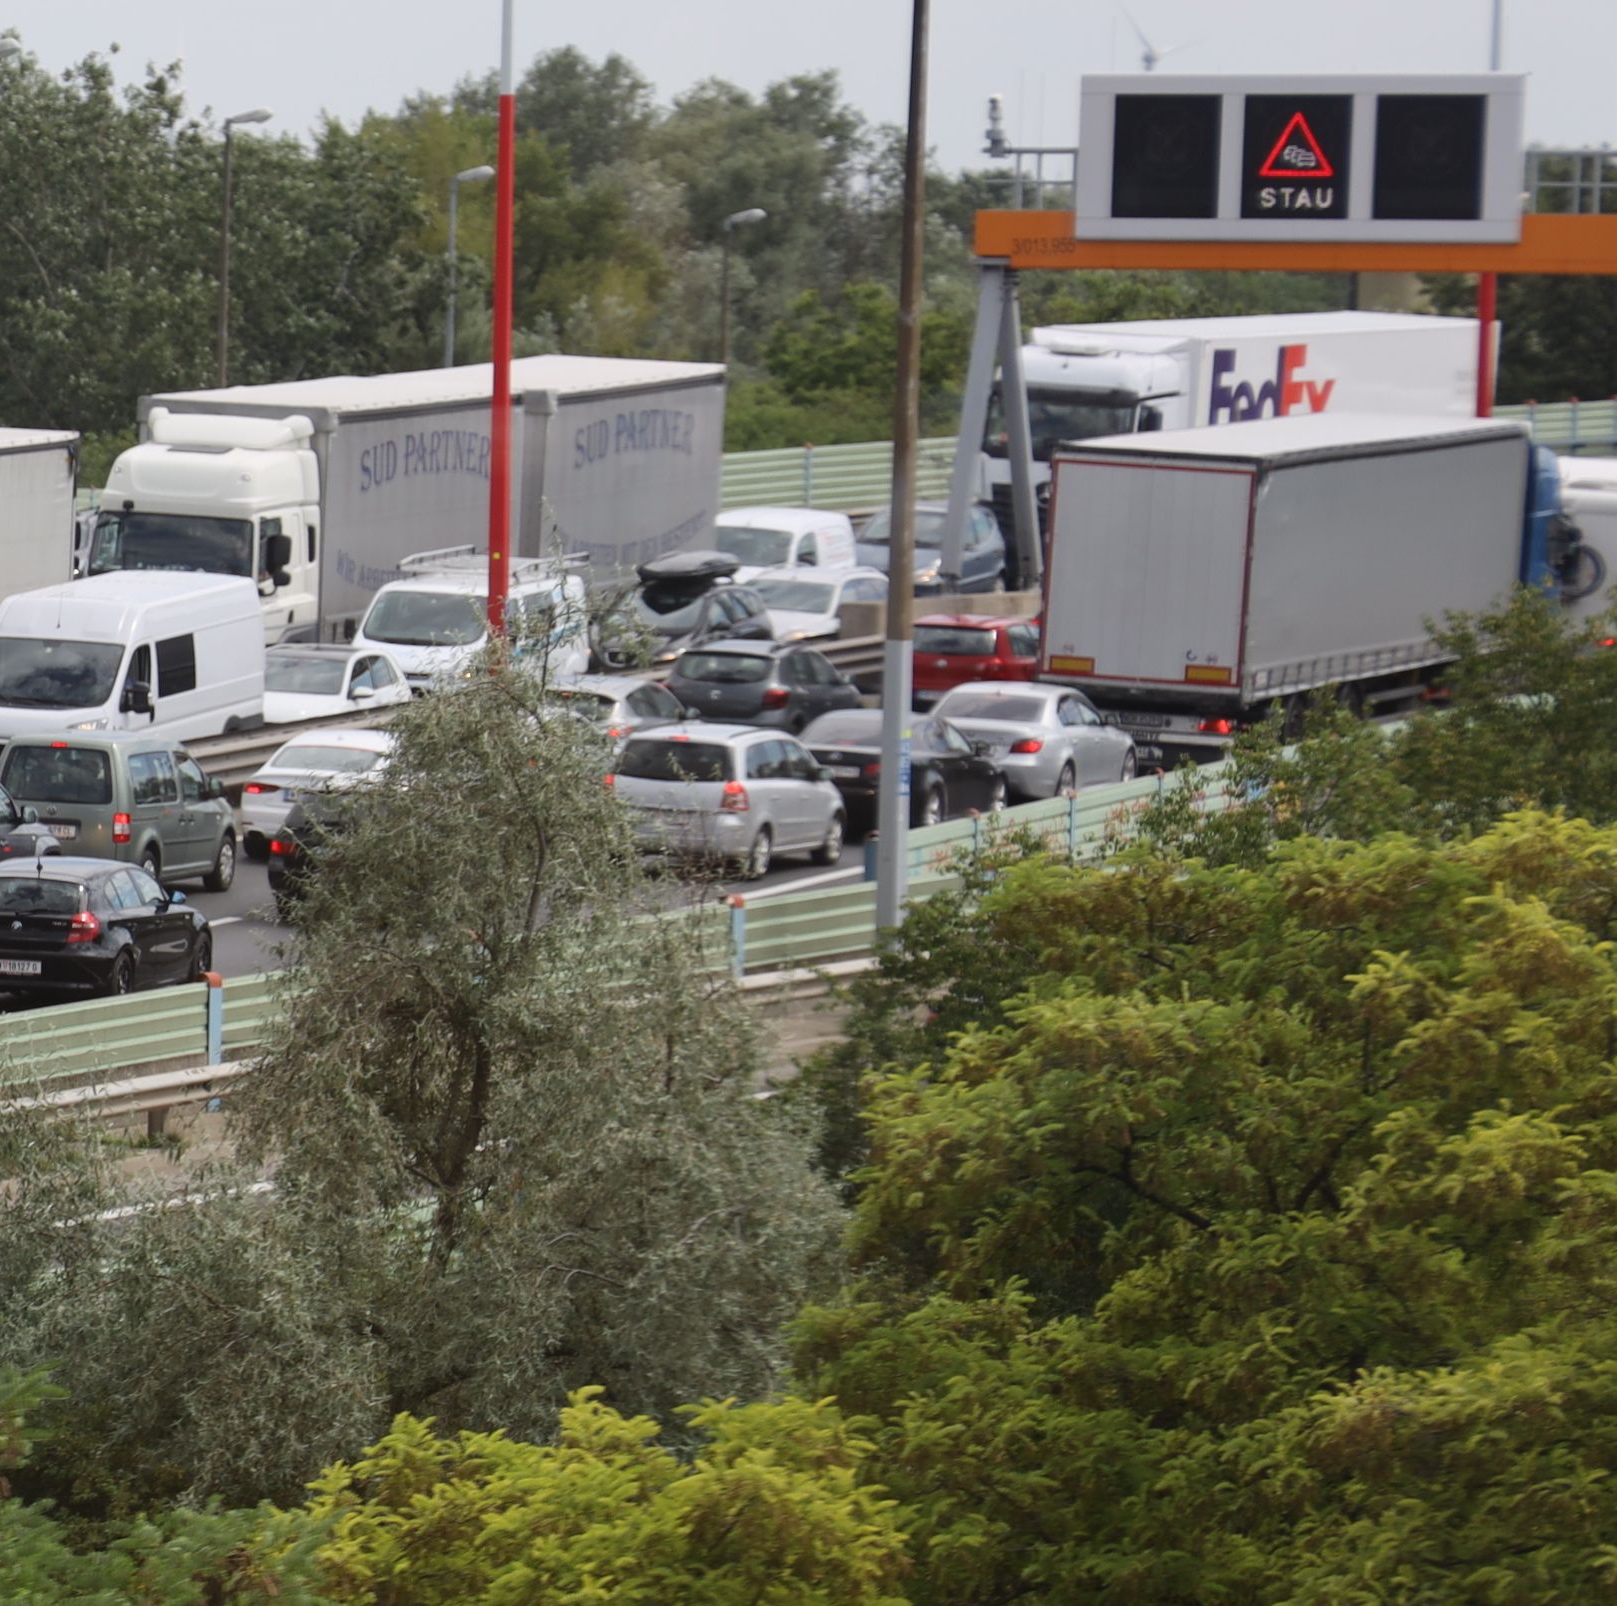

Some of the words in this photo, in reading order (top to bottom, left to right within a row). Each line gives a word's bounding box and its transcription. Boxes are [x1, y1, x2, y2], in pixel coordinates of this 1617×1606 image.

[1259, 187, 1333, 209] STAU
[403, 429, 491, 480] PARTNER
[615, 409, 695, 455] PARTNER
